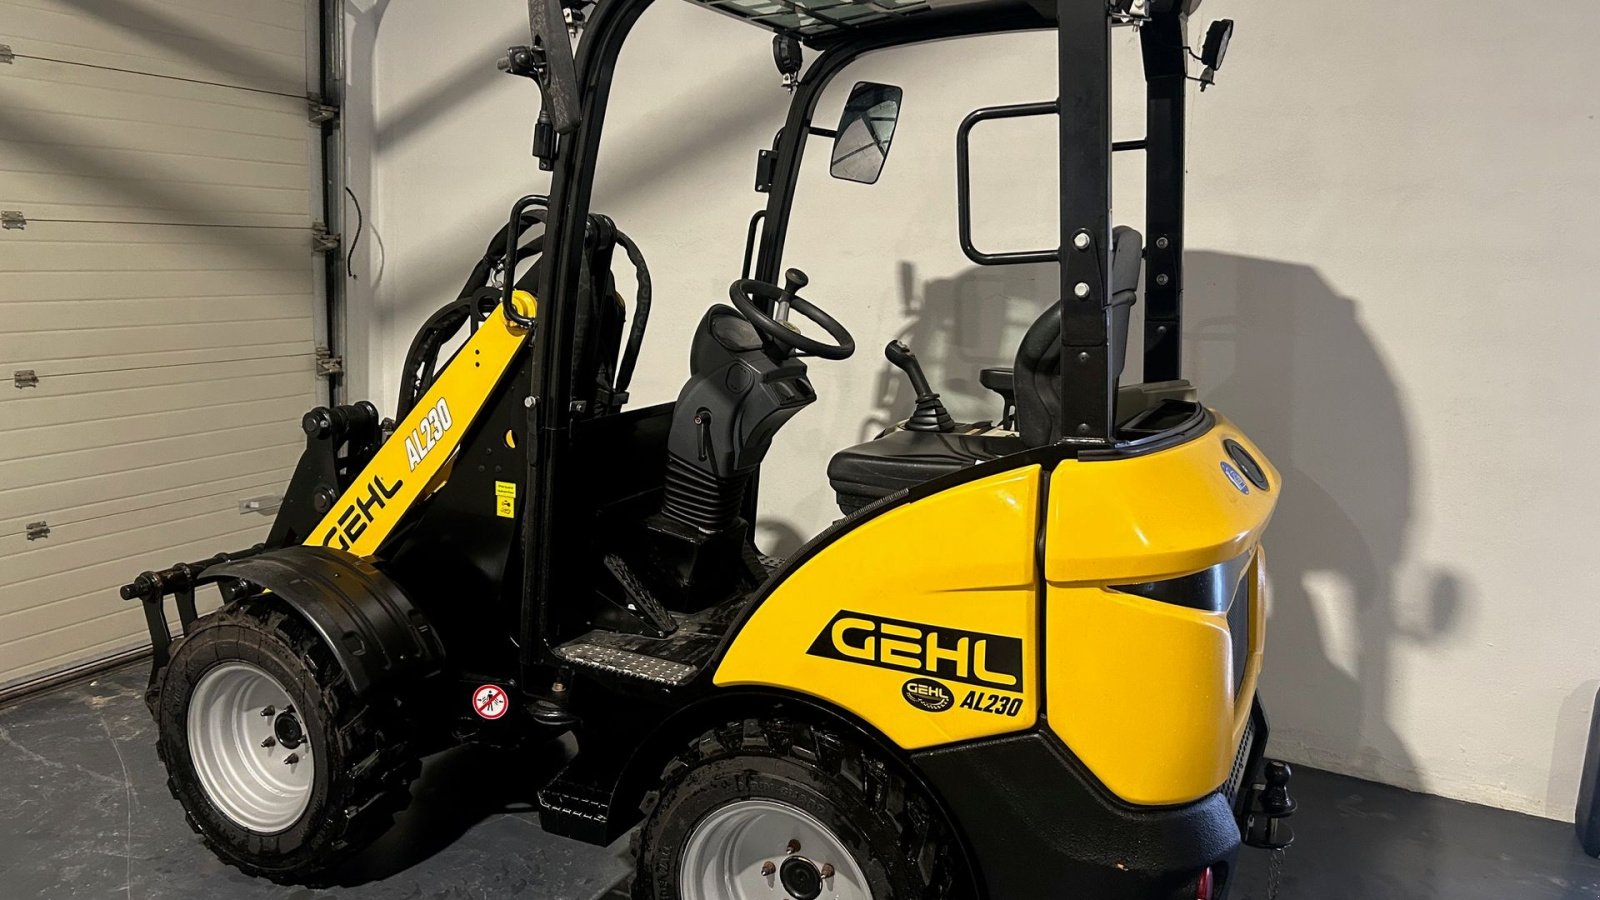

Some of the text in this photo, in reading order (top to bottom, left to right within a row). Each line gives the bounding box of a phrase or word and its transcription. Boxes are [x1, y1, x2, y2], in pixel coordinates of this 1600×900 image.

[404, 396, 453, 472] AL230
[831, 617, 1017, 686] GEHL
[906, 682, 949, 699] GEHL
[959, 690, 1024, 717] AL230
